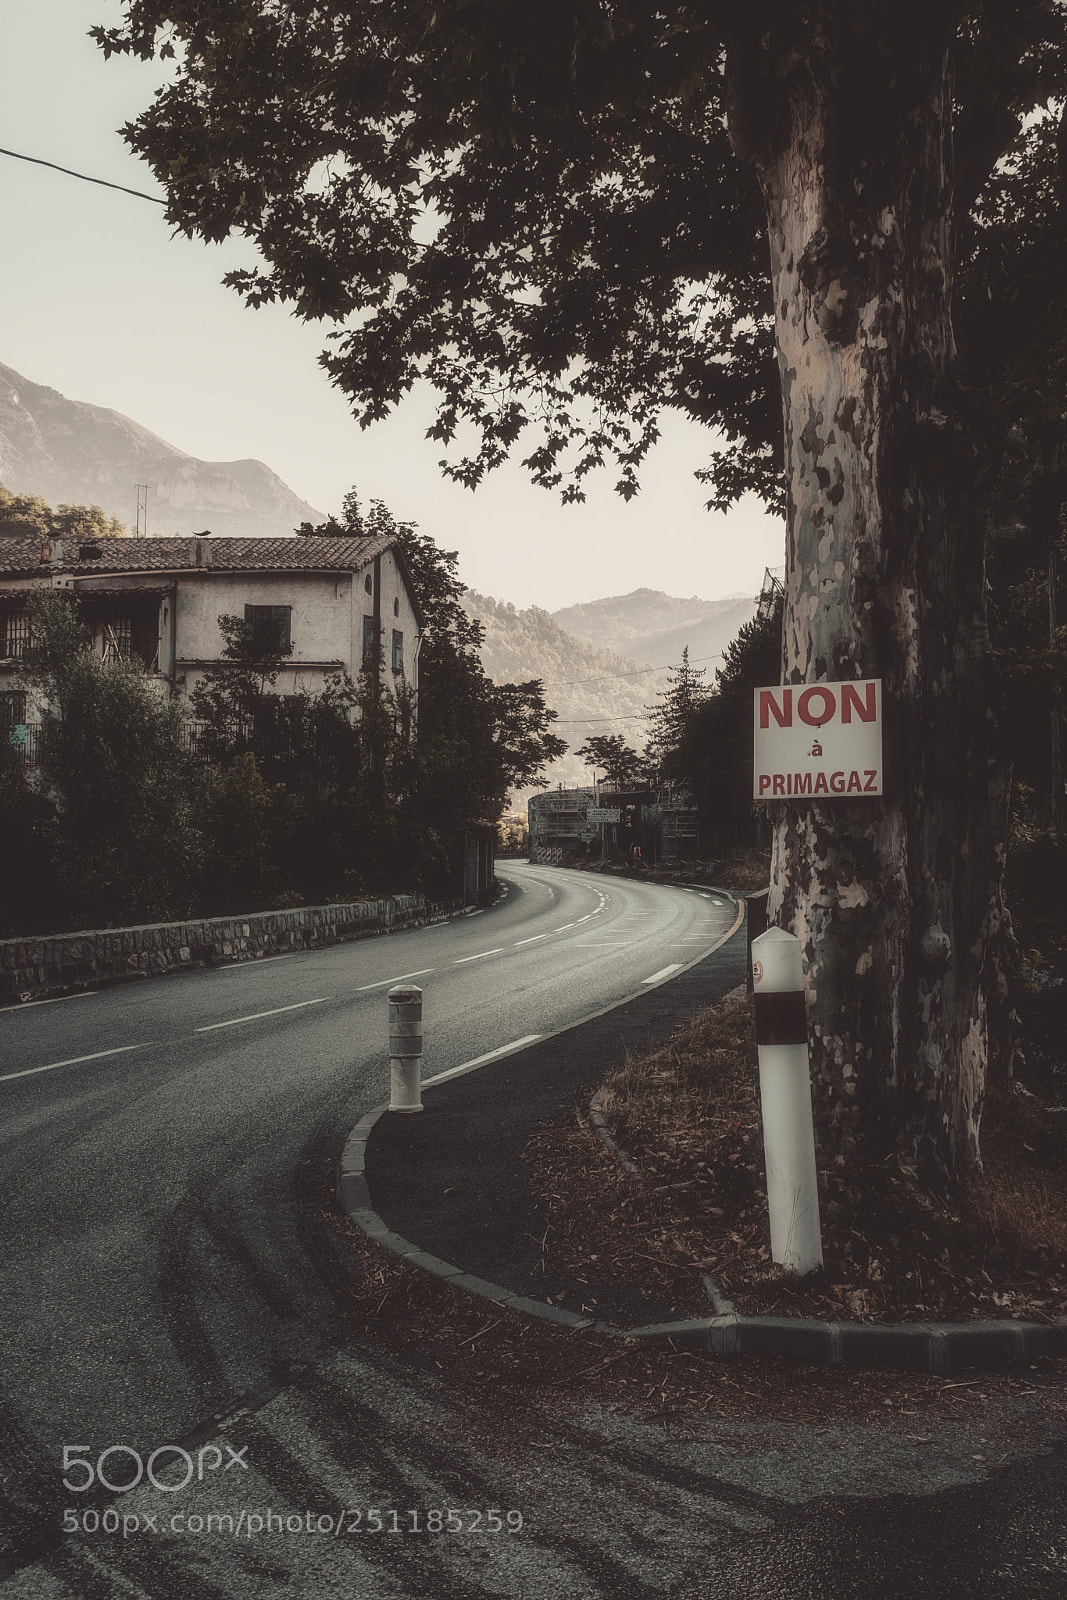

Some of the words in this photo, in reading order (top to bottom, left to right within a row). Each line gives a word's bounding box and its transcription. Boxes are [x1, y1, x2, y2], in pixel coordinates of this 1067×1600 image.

[759, 682, 877, 730] NON
[811, 739, 823, 757] à
[758, 769, 878, 796] PRIMAGAZ
